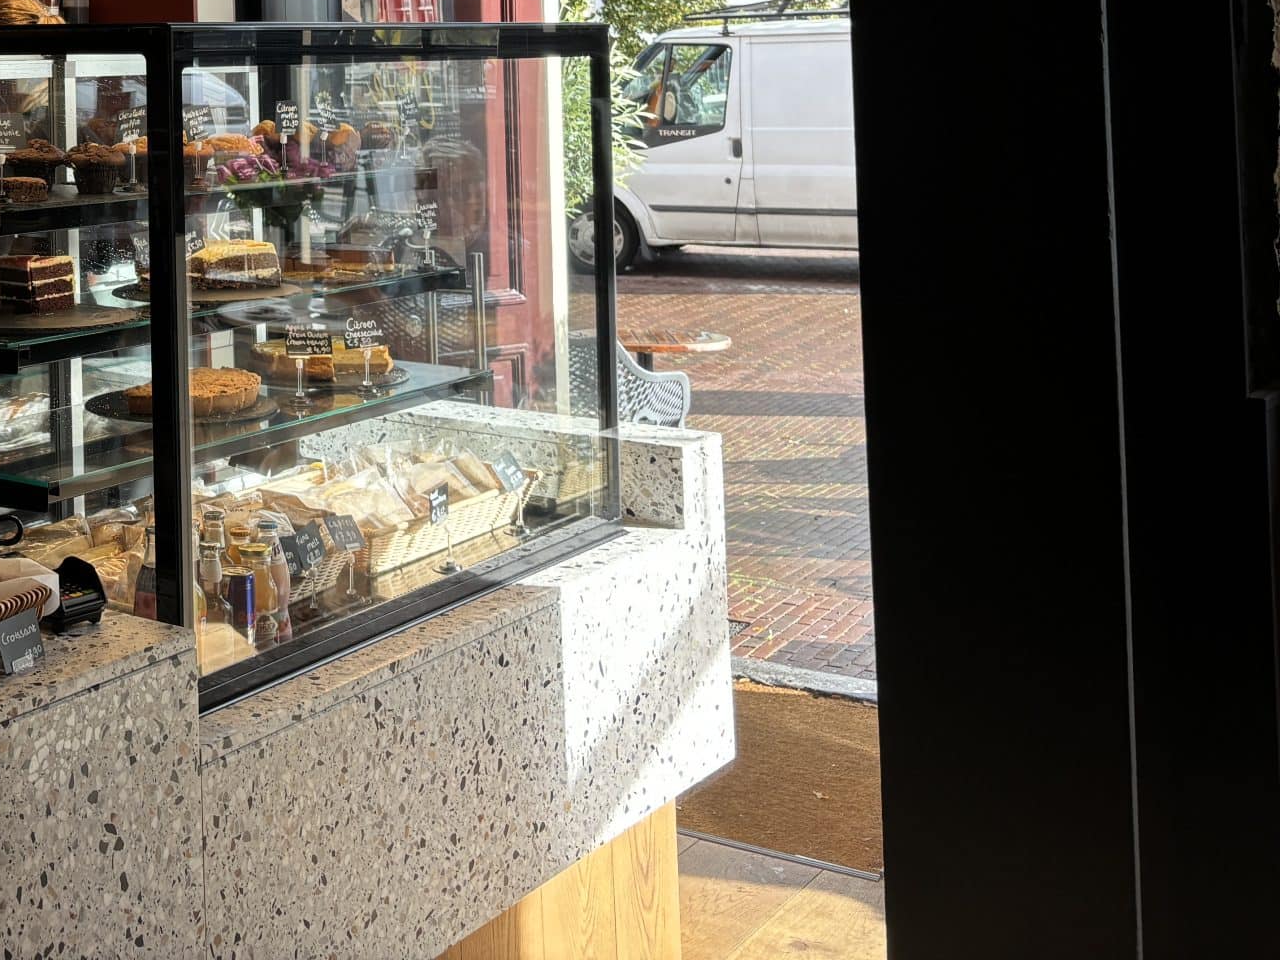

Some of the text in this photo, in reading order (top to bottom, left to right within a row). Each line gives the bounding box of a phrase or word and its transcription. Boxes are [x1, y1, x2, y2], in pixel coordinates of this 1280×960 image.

[276, 102, 298, 113] Citroen
[658, 129, 697, 137] TRANSIT
[346, 317, 377, 332] Citroen
[344, 329, 384, 340] cheesecake
[1, 623, 38, 646] Croissant
